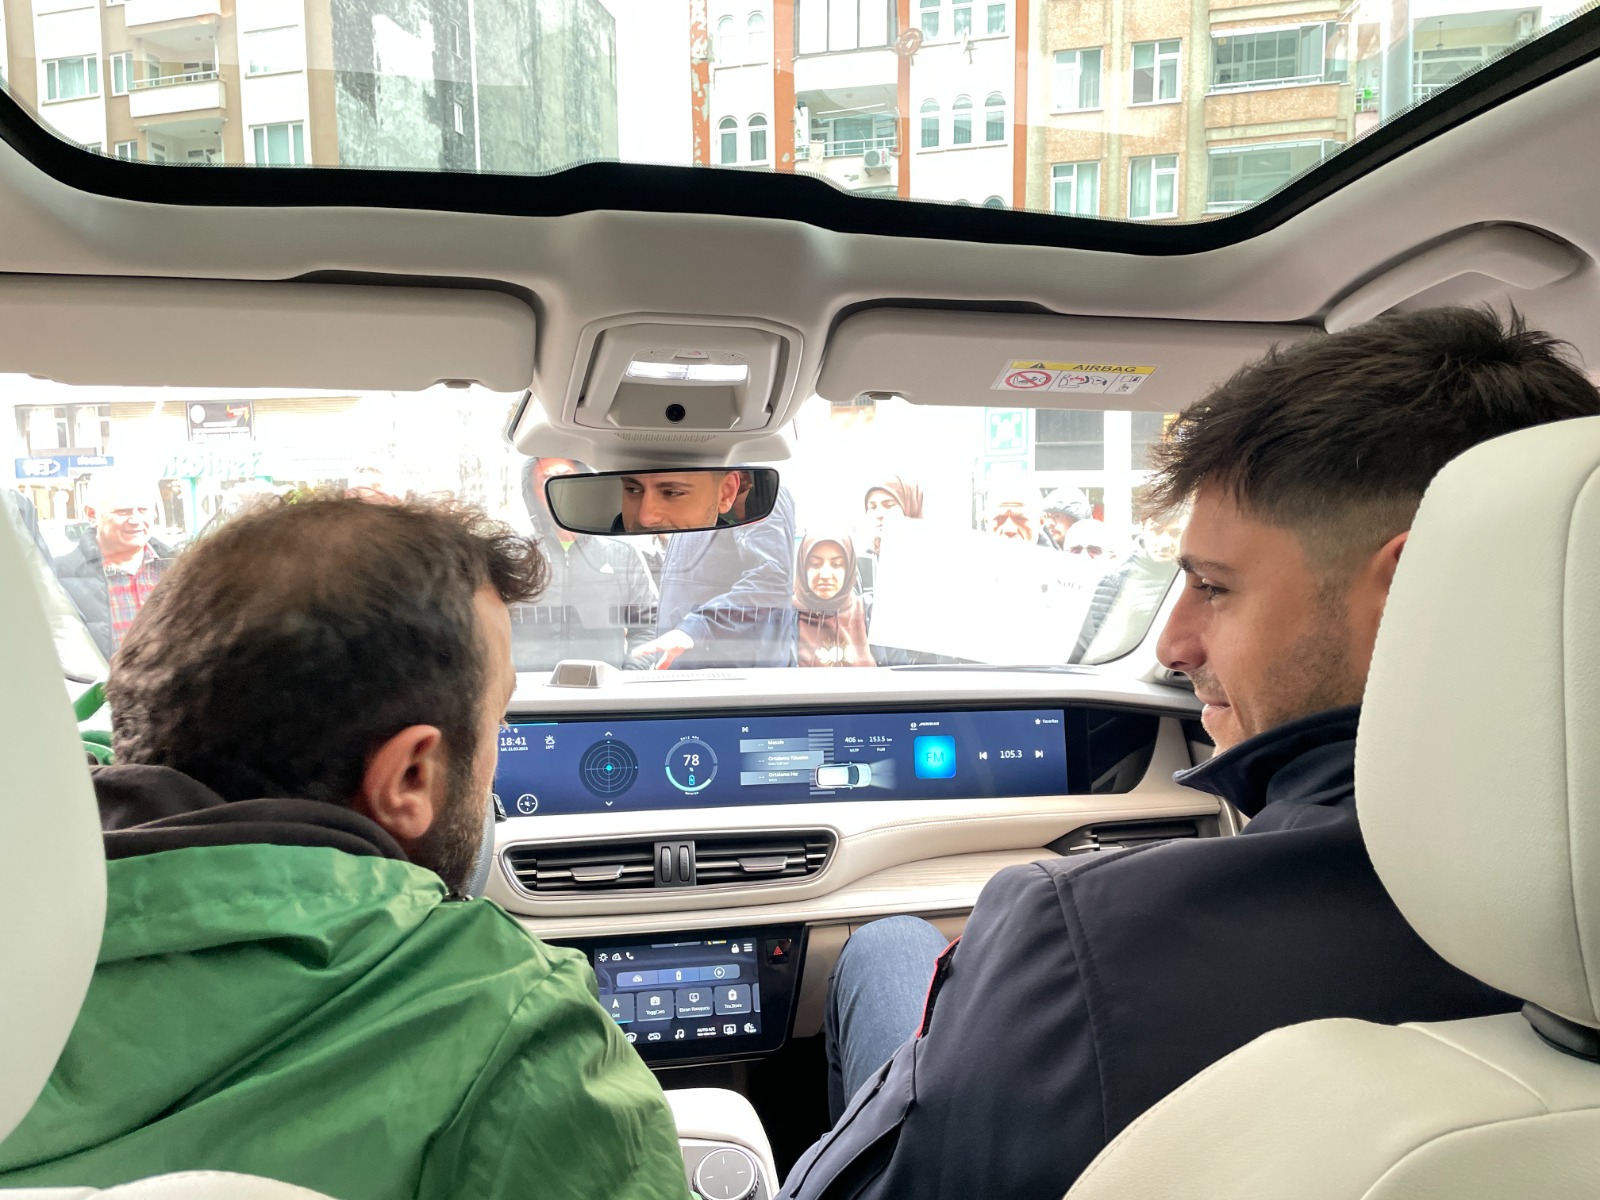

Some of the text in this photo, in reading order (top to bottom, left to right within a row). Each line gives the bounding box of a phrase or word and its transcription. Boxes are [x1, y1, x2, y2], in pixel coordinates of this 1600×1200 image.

[1072, 364, 1137, 373] AIRBAG
[500, 736, 527, 746] 18:41
[682, 753, 700, 767] 78
[926, 751, 945, 763] FM
[999, 750, 1023, 760] 105.3
